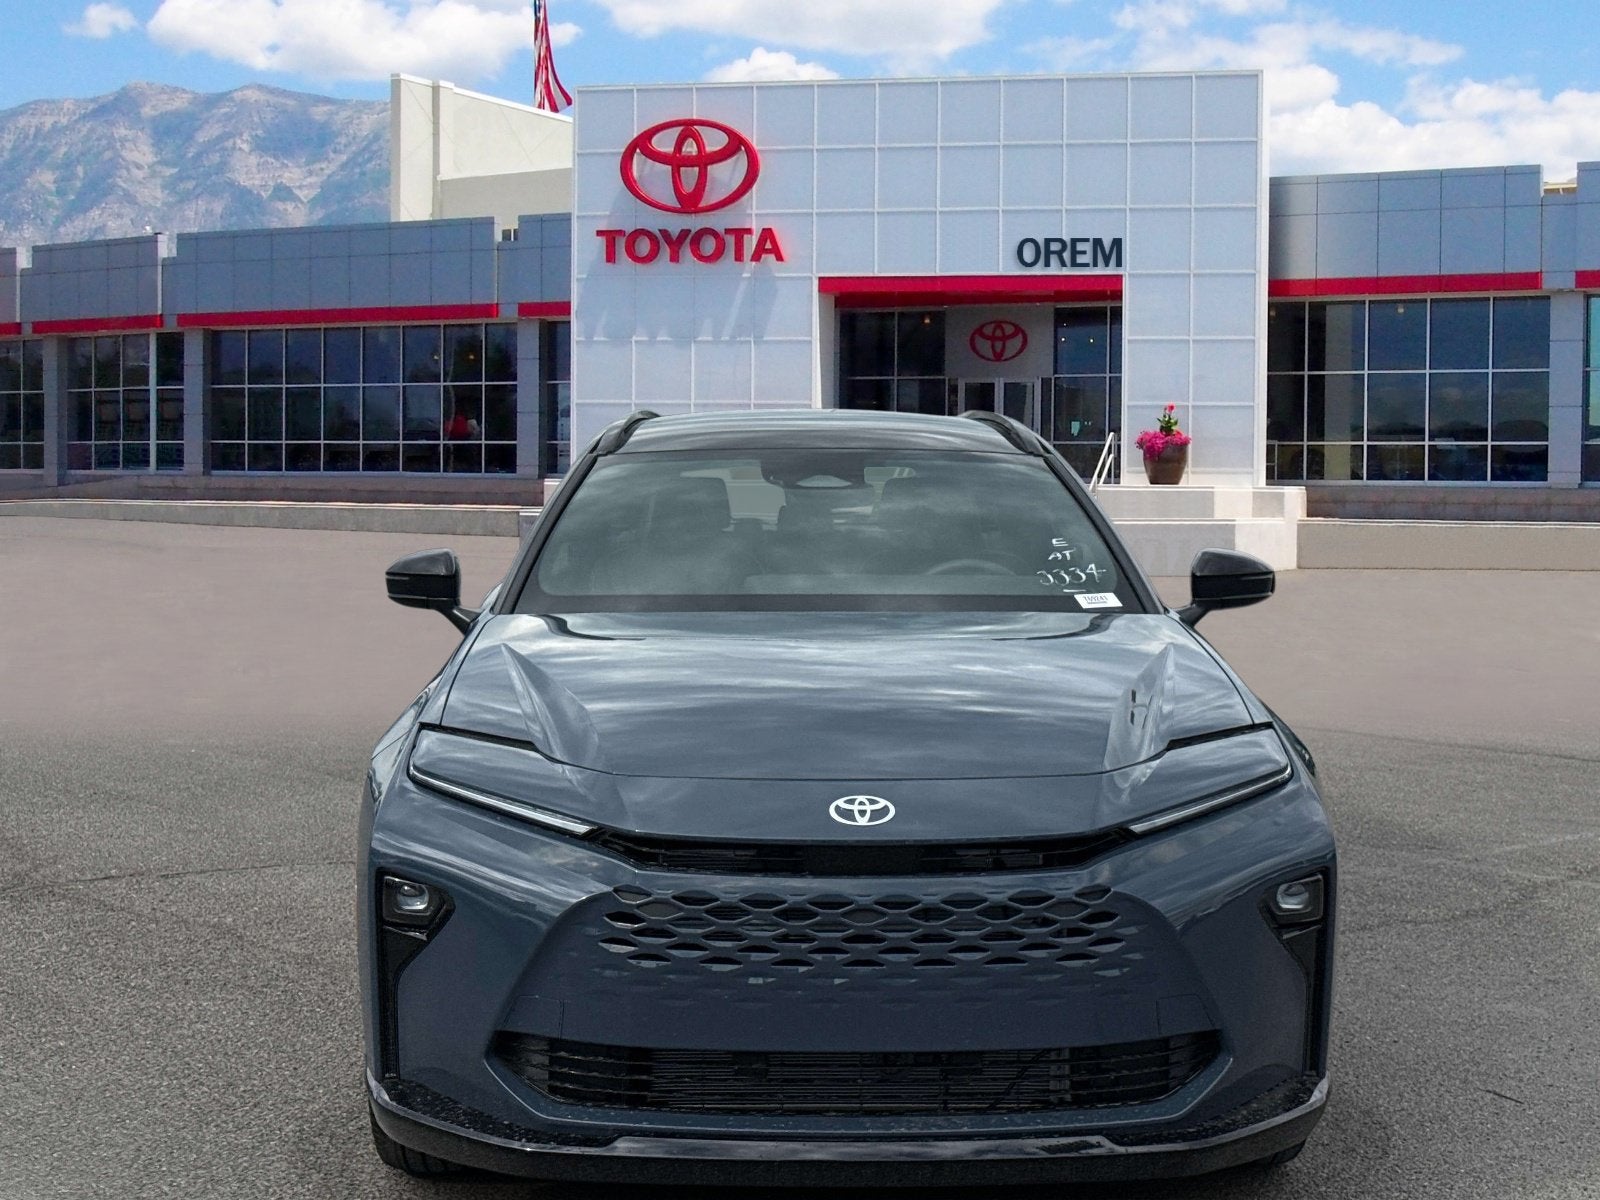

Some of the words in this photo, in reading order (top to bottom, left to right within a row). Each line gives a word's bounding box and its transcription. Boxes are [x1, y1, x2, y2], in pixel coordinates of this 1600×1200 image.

[596, 227, 785, 264] TOYOTA
[1017, 237, 1122, 268] OREM
[1051, 537, 1069, 547] E
